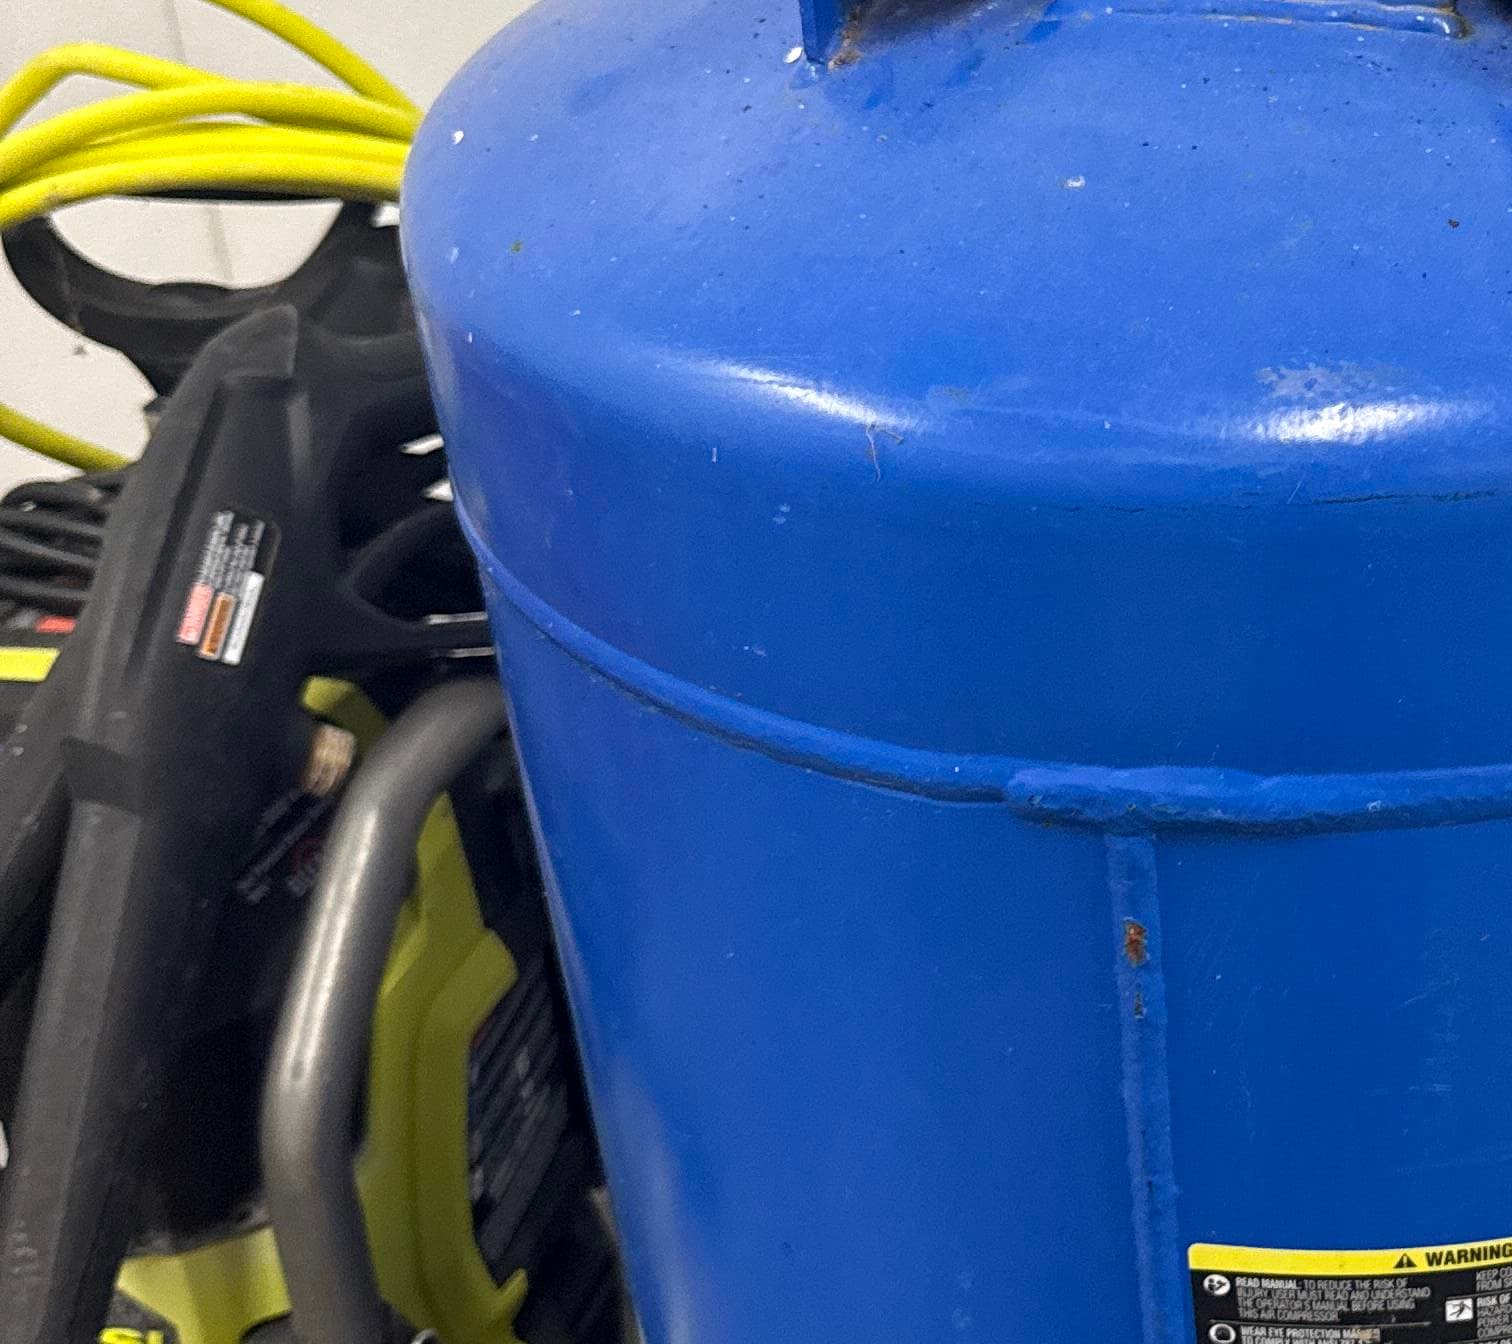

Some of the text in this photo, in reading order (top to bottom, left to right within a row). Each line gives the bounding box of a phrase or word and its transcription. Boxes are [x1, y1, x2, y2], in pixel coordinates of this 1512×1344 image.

[1476, 1268, 1498, 1281] KEEP
[1236, 1277, 1260, 1287] READ
[1304, 1280, 1316, 1290] TO
[1318, 1280, 1352, 1290] REDUCE
[1355, 1280, 1372, 1290] THE
[1374, 1279, 1394, 1289] RISK
[1396, 1278, 1408, 1288] OF
[1477, 1295, 1498, 1307] RISK
[1499, 1293, 1511, 1304] OF
[1241, 1326, 1266, 1336] WEAR
[1268, 1328, 1284, 1338] EYE
[1286, 1328, 1341, 1338] PROTECTION
